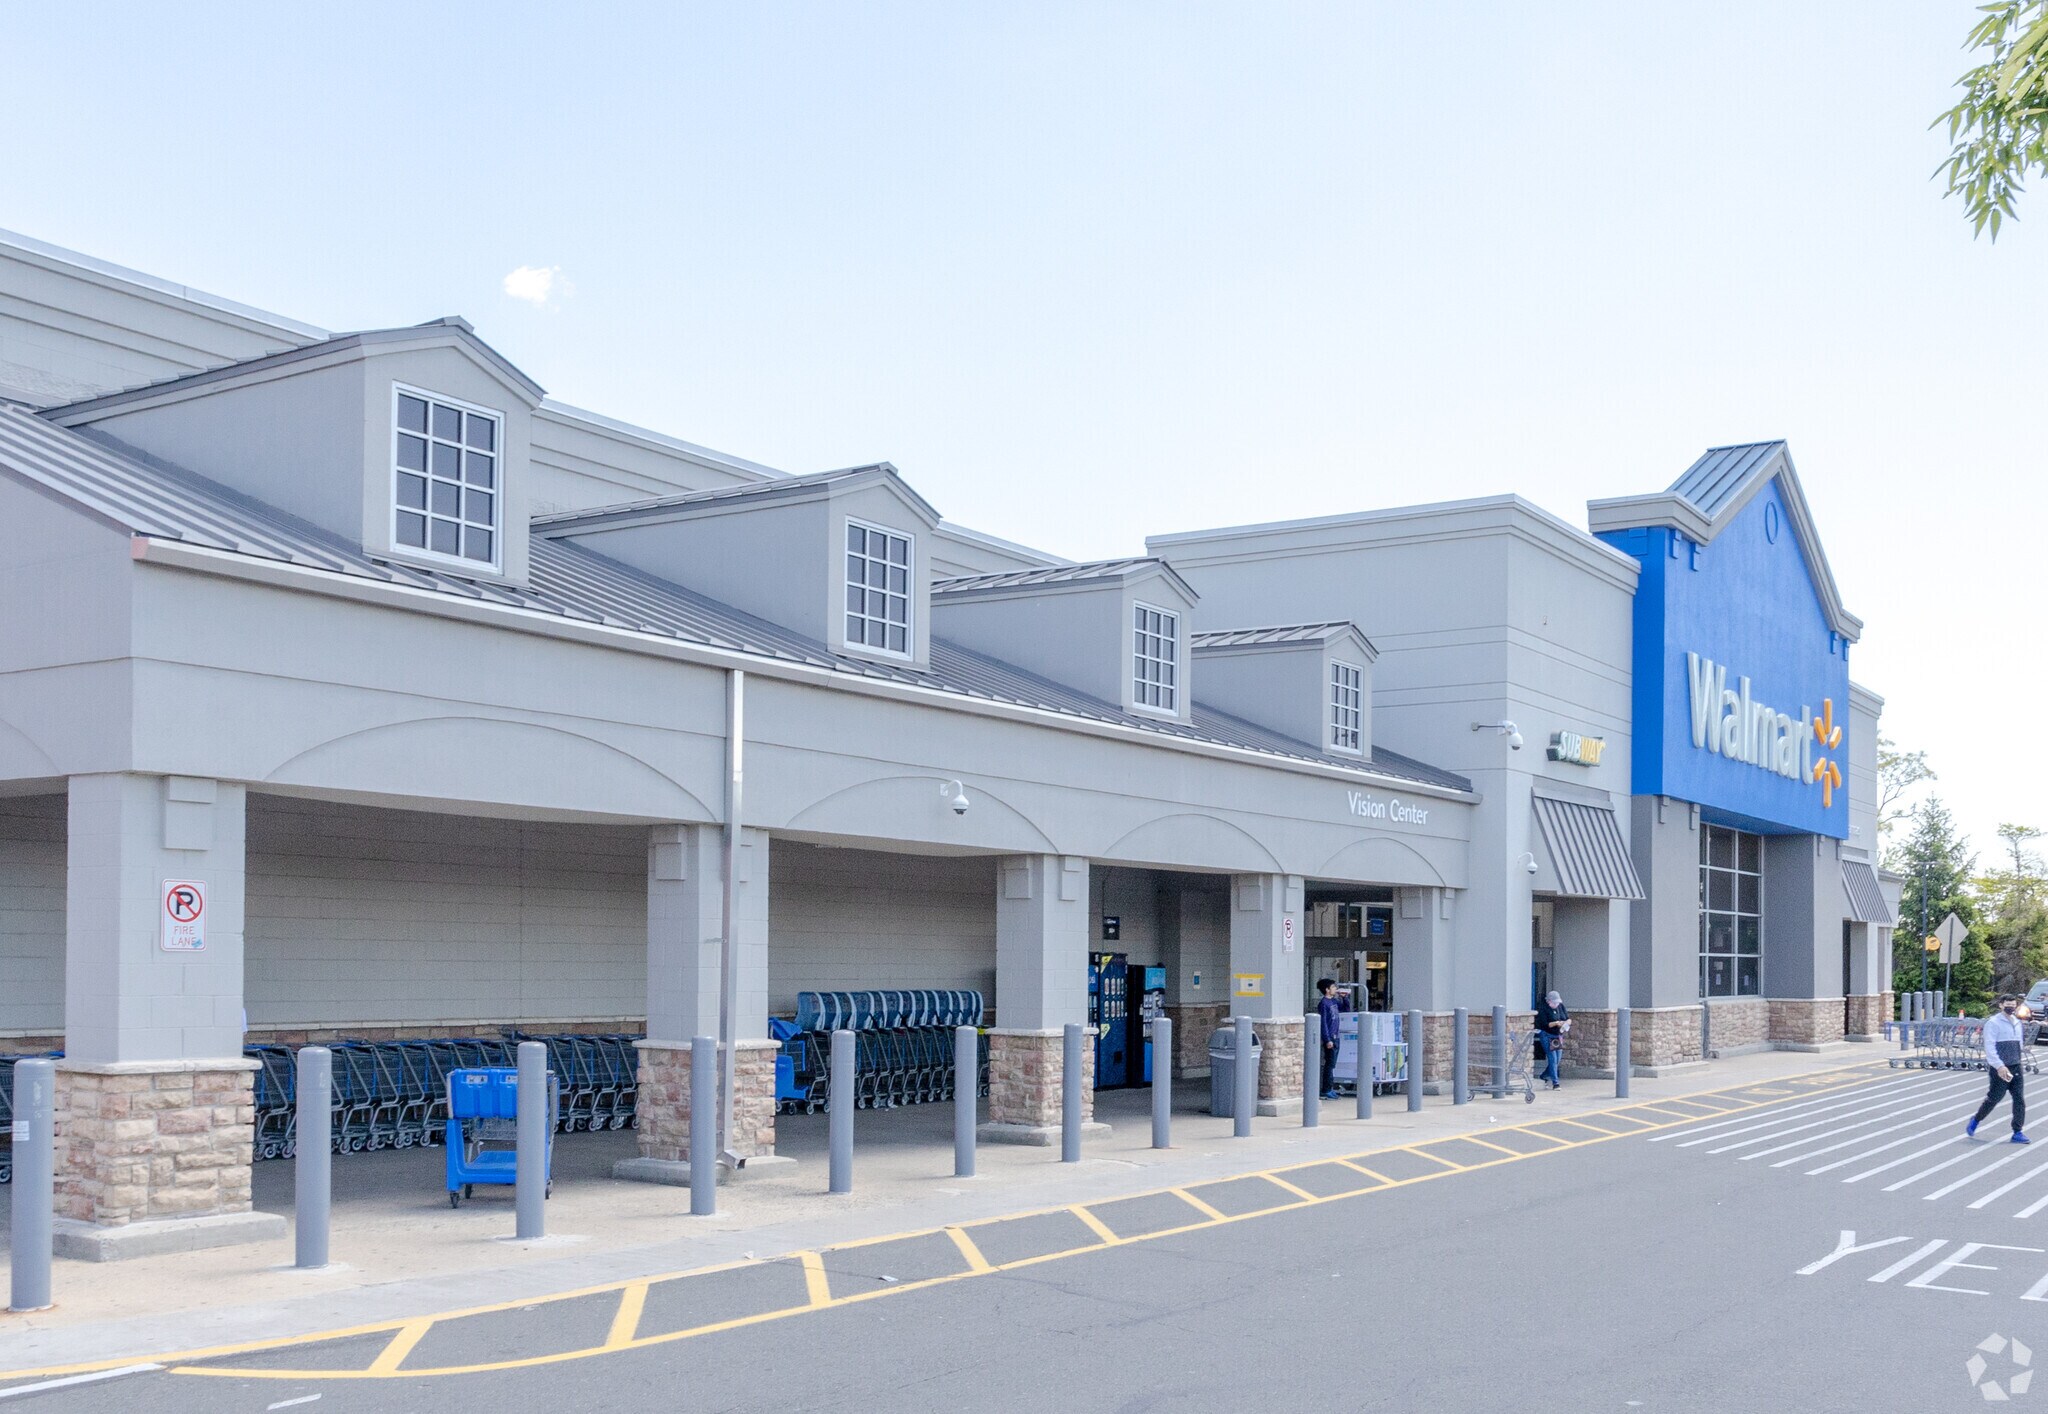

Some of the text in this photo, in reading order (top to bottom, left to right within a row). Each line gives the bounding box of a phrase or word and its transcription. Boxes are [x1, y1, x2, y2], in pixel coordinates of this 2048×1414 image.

[1687, 651, 1814, 785] Walmart
[1558, 731, 1605, 765] SUBWAY
[1347, 791, 1428, 825] Vision Center
[171, 936, 197, 947] LANE
[173, 925, 195, 935] FIRE
